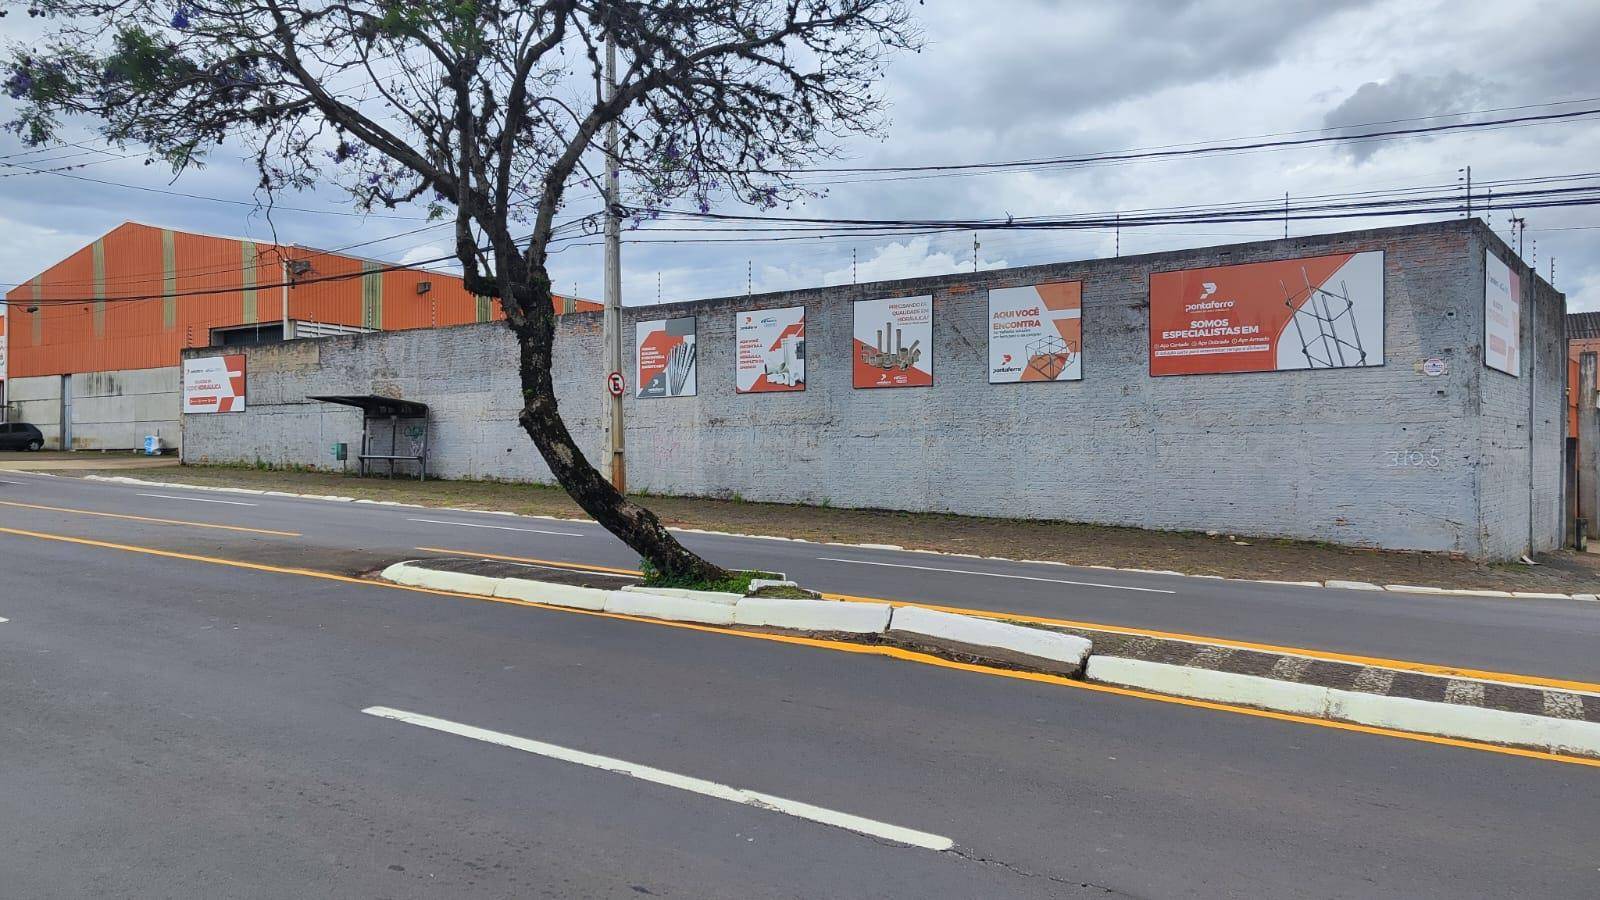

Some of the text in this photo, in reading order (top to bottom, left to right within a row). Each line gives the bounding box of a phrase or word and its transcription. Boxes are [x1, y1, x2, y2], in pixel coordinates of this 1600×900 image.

[993, 307, 1040, 319] AQUI VOCÊ
[993, 319, 1042, 330] ENCONTRA
[1190, 318, 1229, 329] SOMOS
[1162, 325, 1259, 340] ESPECIALISTAS EM
